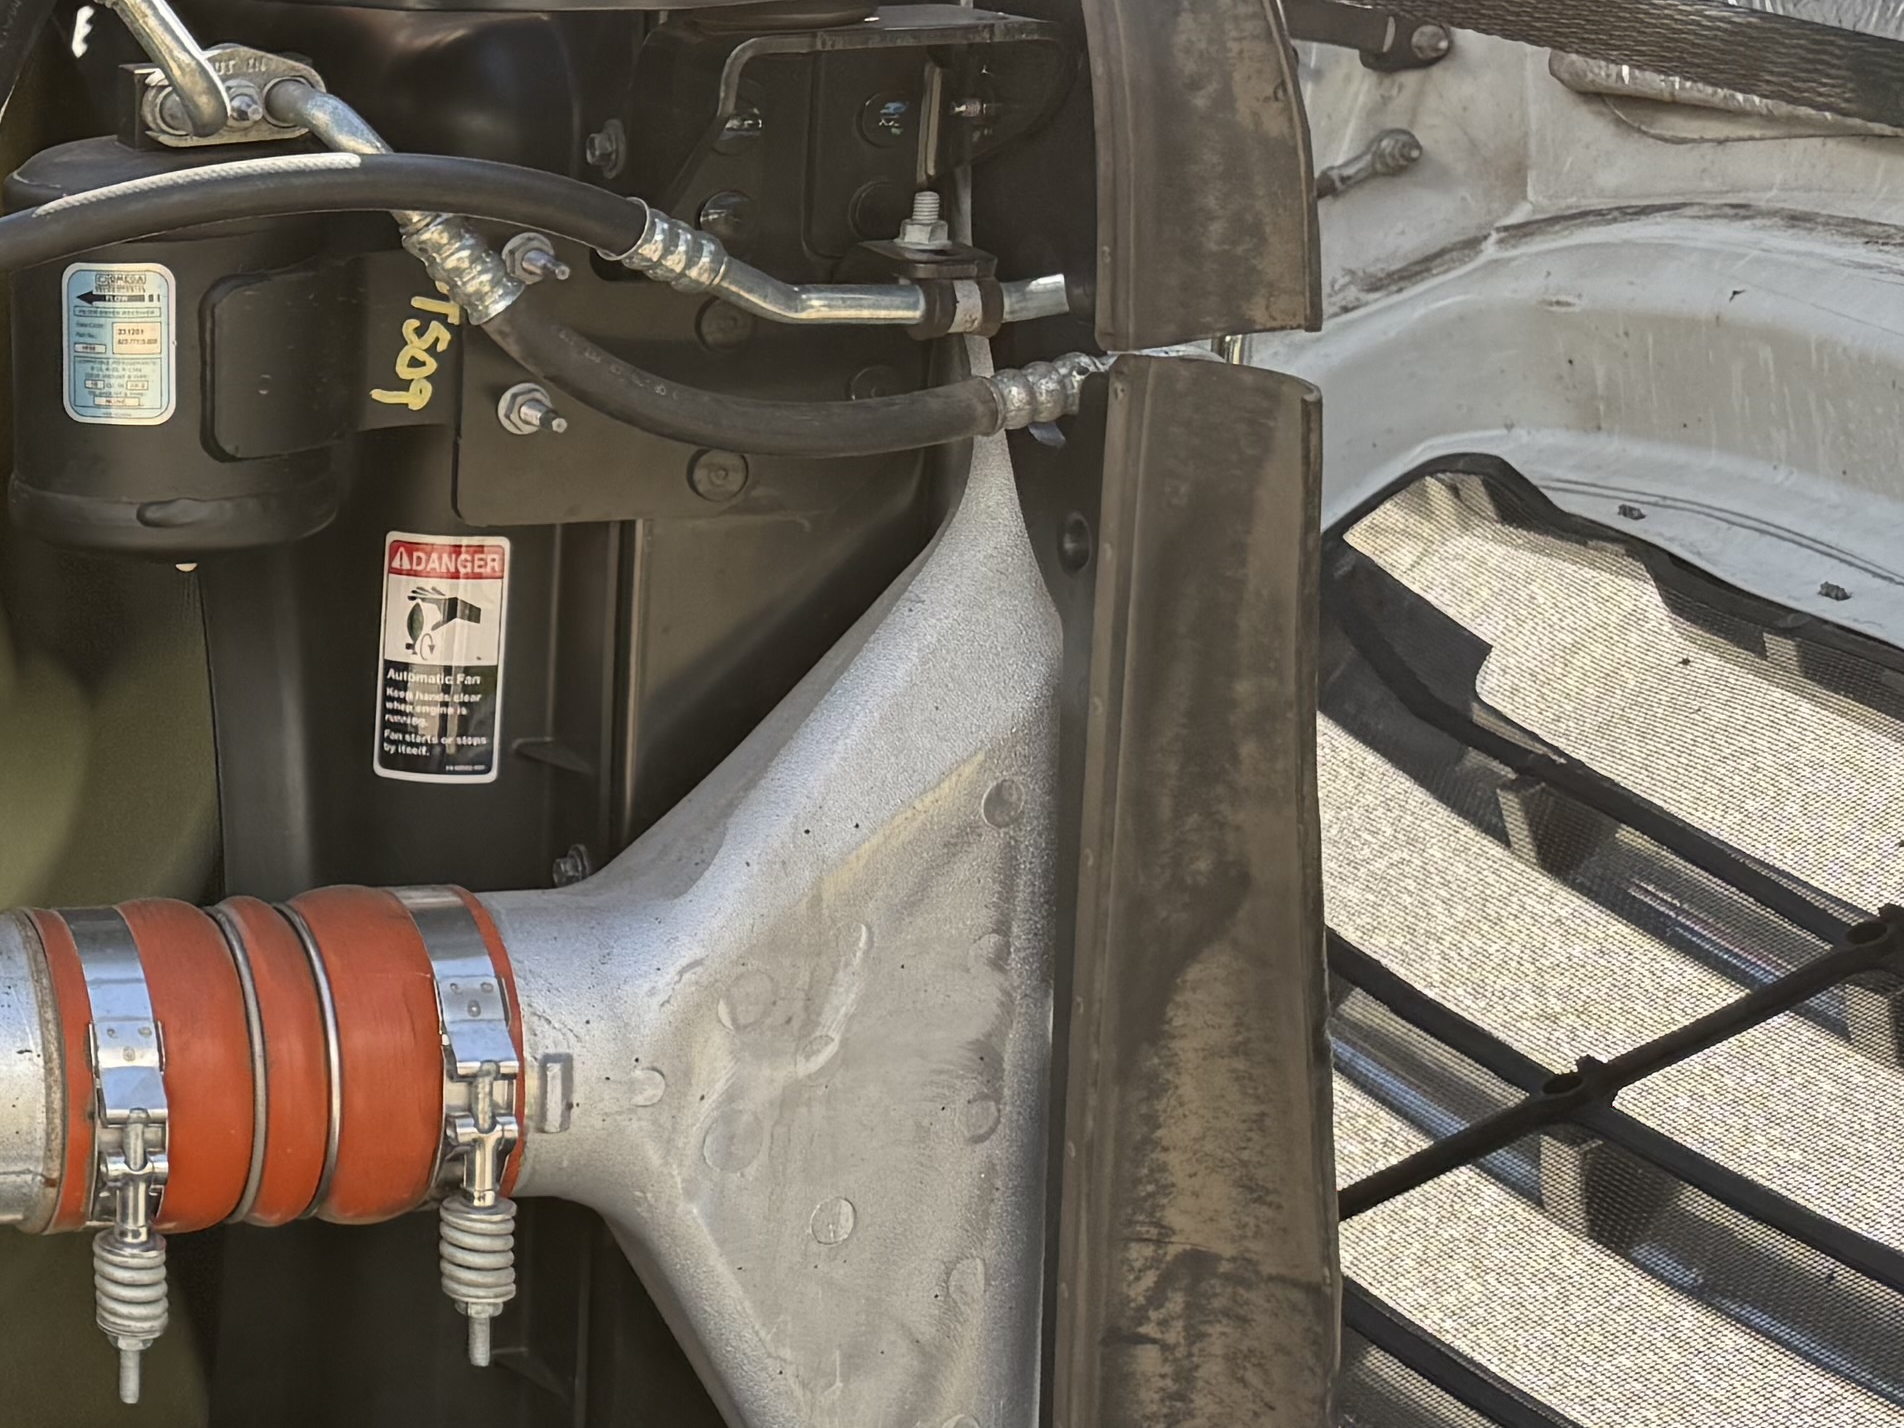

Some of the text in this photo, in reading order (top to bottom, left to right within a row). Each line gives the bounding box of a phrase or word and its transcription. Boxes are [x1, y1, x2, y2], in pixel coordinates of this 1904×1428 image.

[411, 550, 500, 574] DANGER
[387, 668, 481, 685] Automatic Fan
[386, 687, 482, 703] Keep hands clear
[385, 700, 414, 713] when
[415, 704, 454, 716] engine
[384, 729, 403, 741] Fan
[404, 732, 439, 744] starts
[456, 736, 487, 747] stops
[383, 742, 396, 754] by
